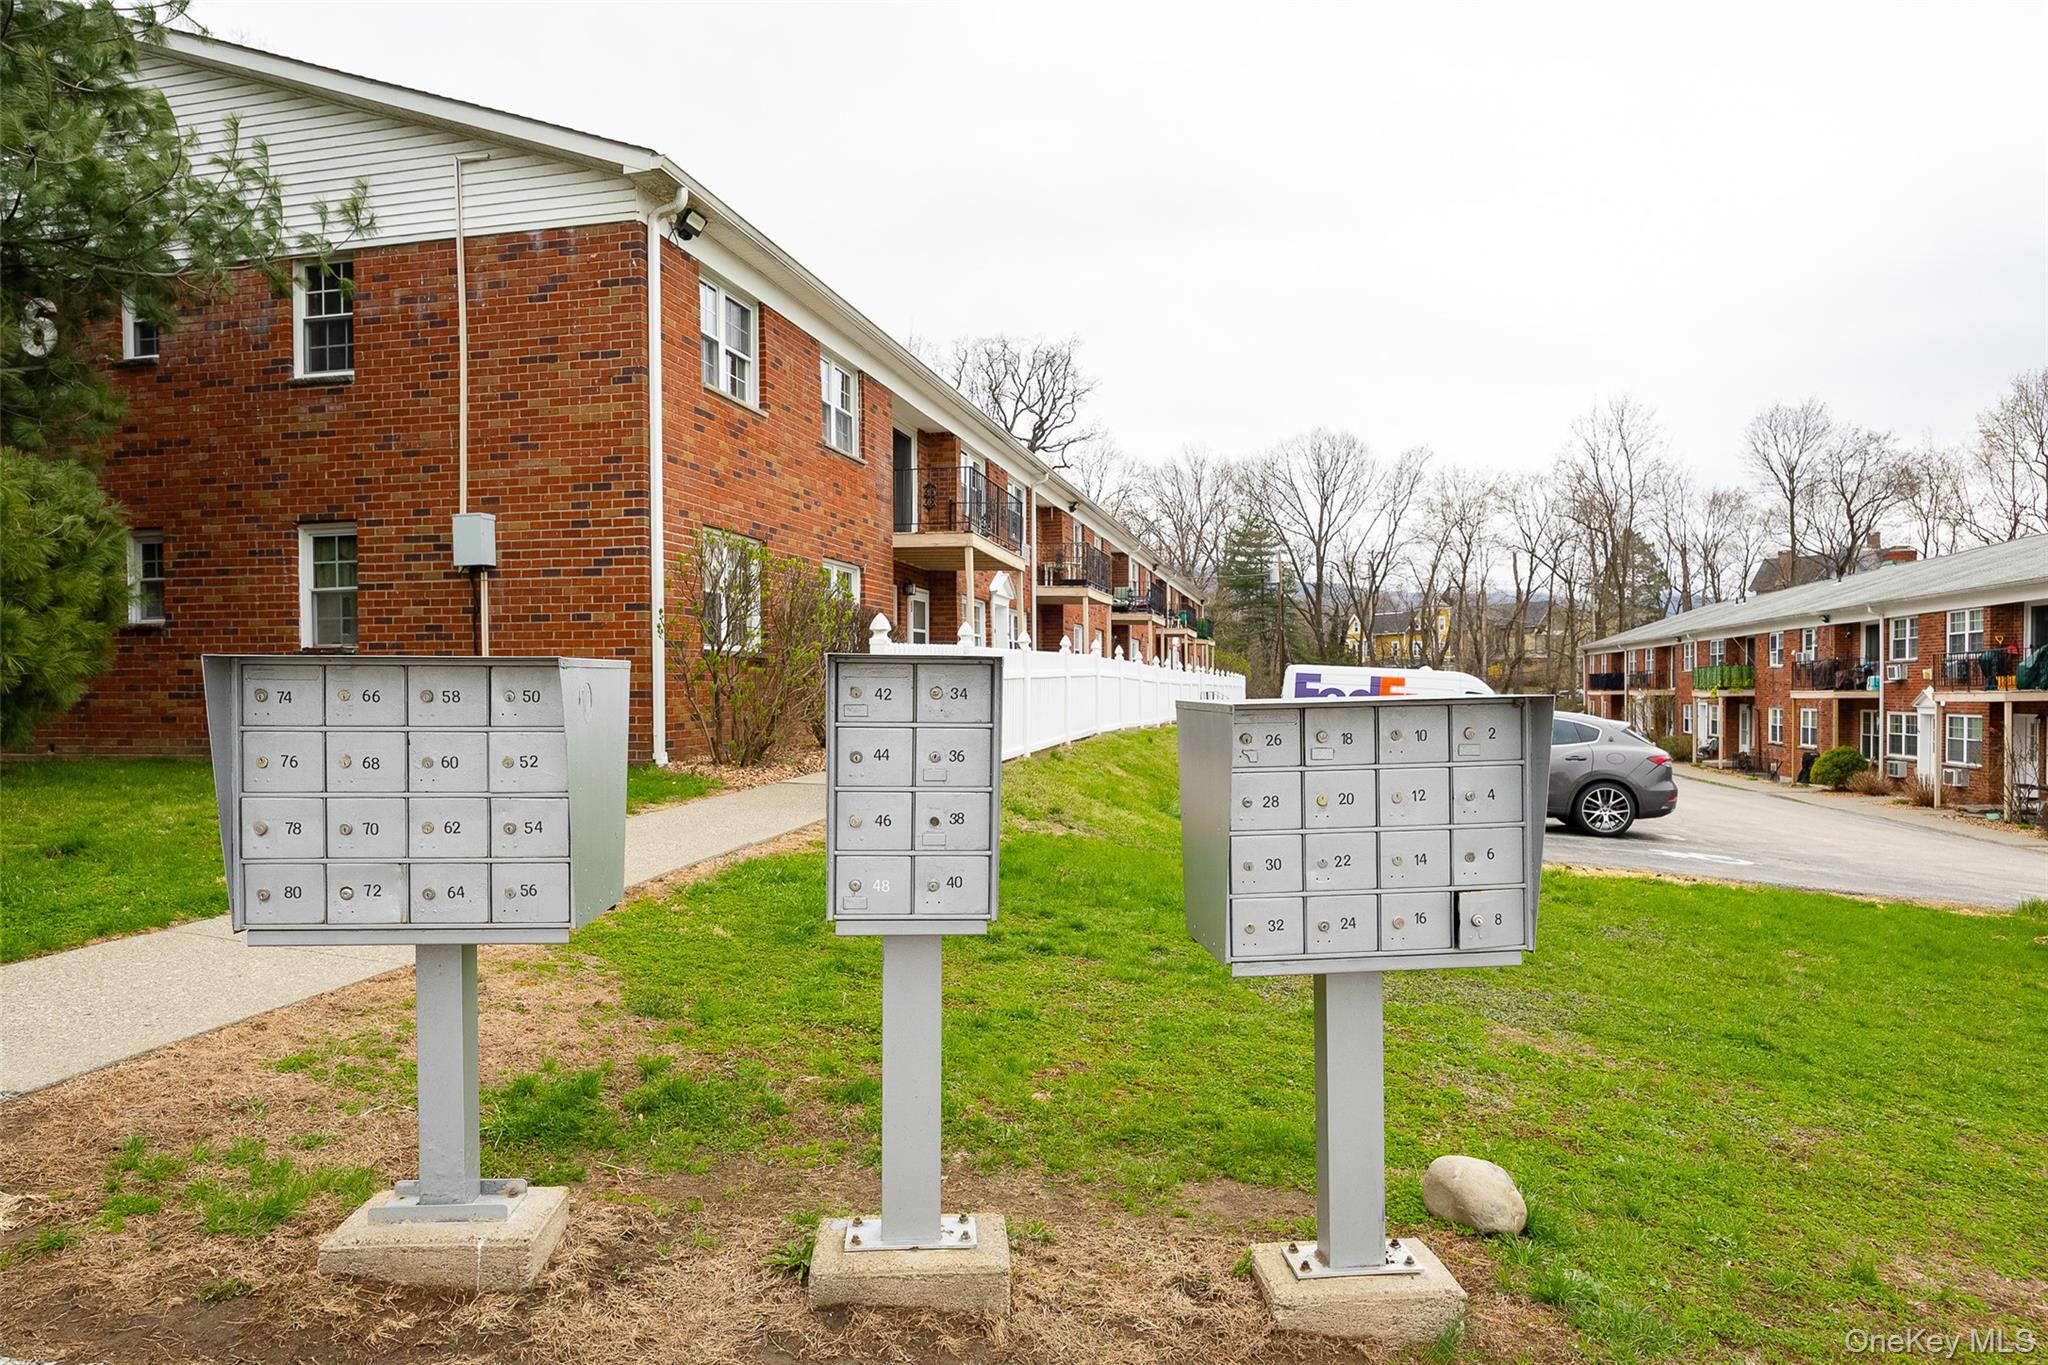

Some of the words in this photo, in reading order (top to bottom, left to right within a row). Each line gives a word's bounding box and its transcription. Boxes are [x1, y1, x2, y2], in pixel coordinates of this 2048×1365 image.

[20, 297, 58, 358] 6
[277, 691, 291, 703] 74
[363, 690, 380, 702] 66
[443, 690, 460, 703] 58
[523, 690, 540, 702] 50
[875, 688, 891, 700] 42
[951, 688, 967, 699] 34
[1341, 733, 1353, 744] 18
[1415, 729, 1427, 741] 10
[1489, 727, 1495, 739] 2
[1266, 734, 1281, 746] 26
[874, 749, 889, 760] 44
[949, 750, 965, 762] 36
[281, 755, 298, 768] 76
[363, 757, 380, 769] 68
[442, 756, 458, 768] 60
[520, 755, 538, 768] 52
[1339, 793, 1354, 805] 20
[1412, 789, 1426, 801] 12
[1488, 789, 1494, 800] 4
[1263, 796, 1279, 808] 28
[875, 815, 891, 826] 46
[950, 813, 964, 824] 38
[286, 822, 301, 835] 78
[363, 822, 378, 835] 70
[444, 821, 460, 834] 62
[525, 821, 542, 834] 54
[1415, 854, 1427, 865] 14
[1487, 848, 1494, 859] 6
[1266, 858, 1281, 870] 30
[1335, 855, 1351, 867] 22
[873, 880, 889, 892] 48
[947, 876, 962, 888] 40
[285, 886, 301, 898] 80
[364, 884, 381, 896] 72
[448, 886, 464, 898] 64
[521, 884, 537, 897] 56
[1341, 917, 1356, 929] 24
[1415, 912, 1426, 924] 16
[1495, 913, 1502, 925] 8
[1268, 919, 1284, 932] 32
